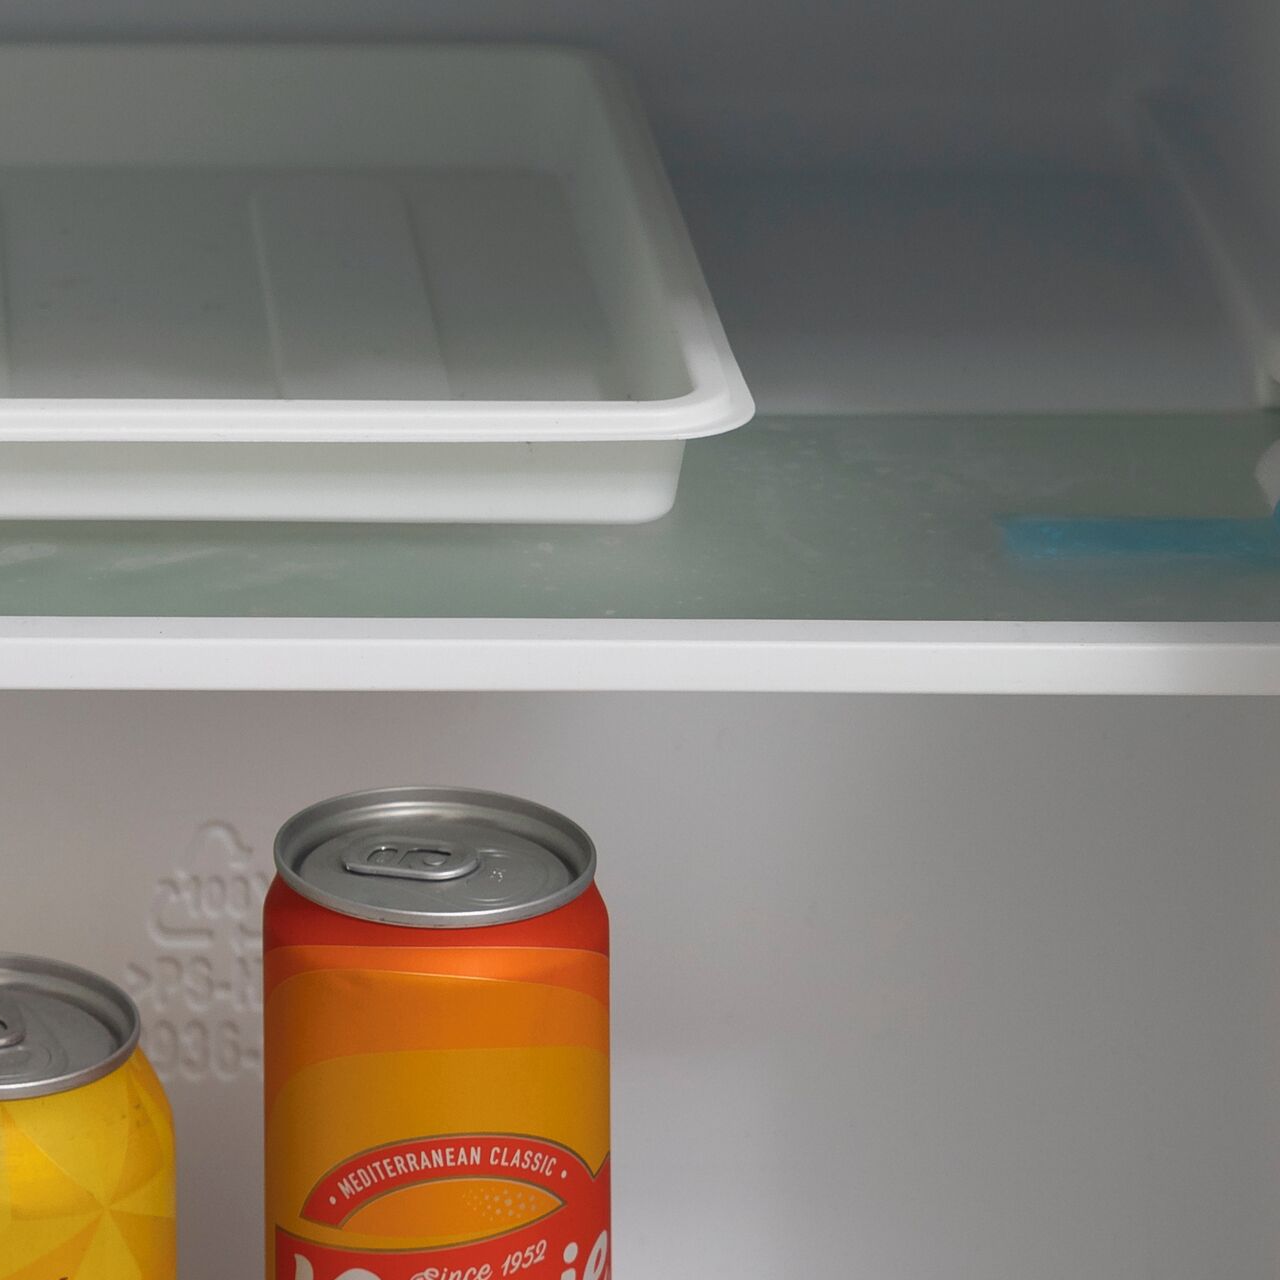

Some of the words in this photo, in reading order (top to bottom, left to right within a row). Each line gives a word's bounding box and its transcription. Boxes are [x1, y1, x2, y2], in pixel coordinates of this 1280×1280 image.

[337, 1146, 482, 1199] MEDITERRANEAN
[489, 1146, 557, 1177] CLASSIC
[501, 1239, 548, 1278] 1952
